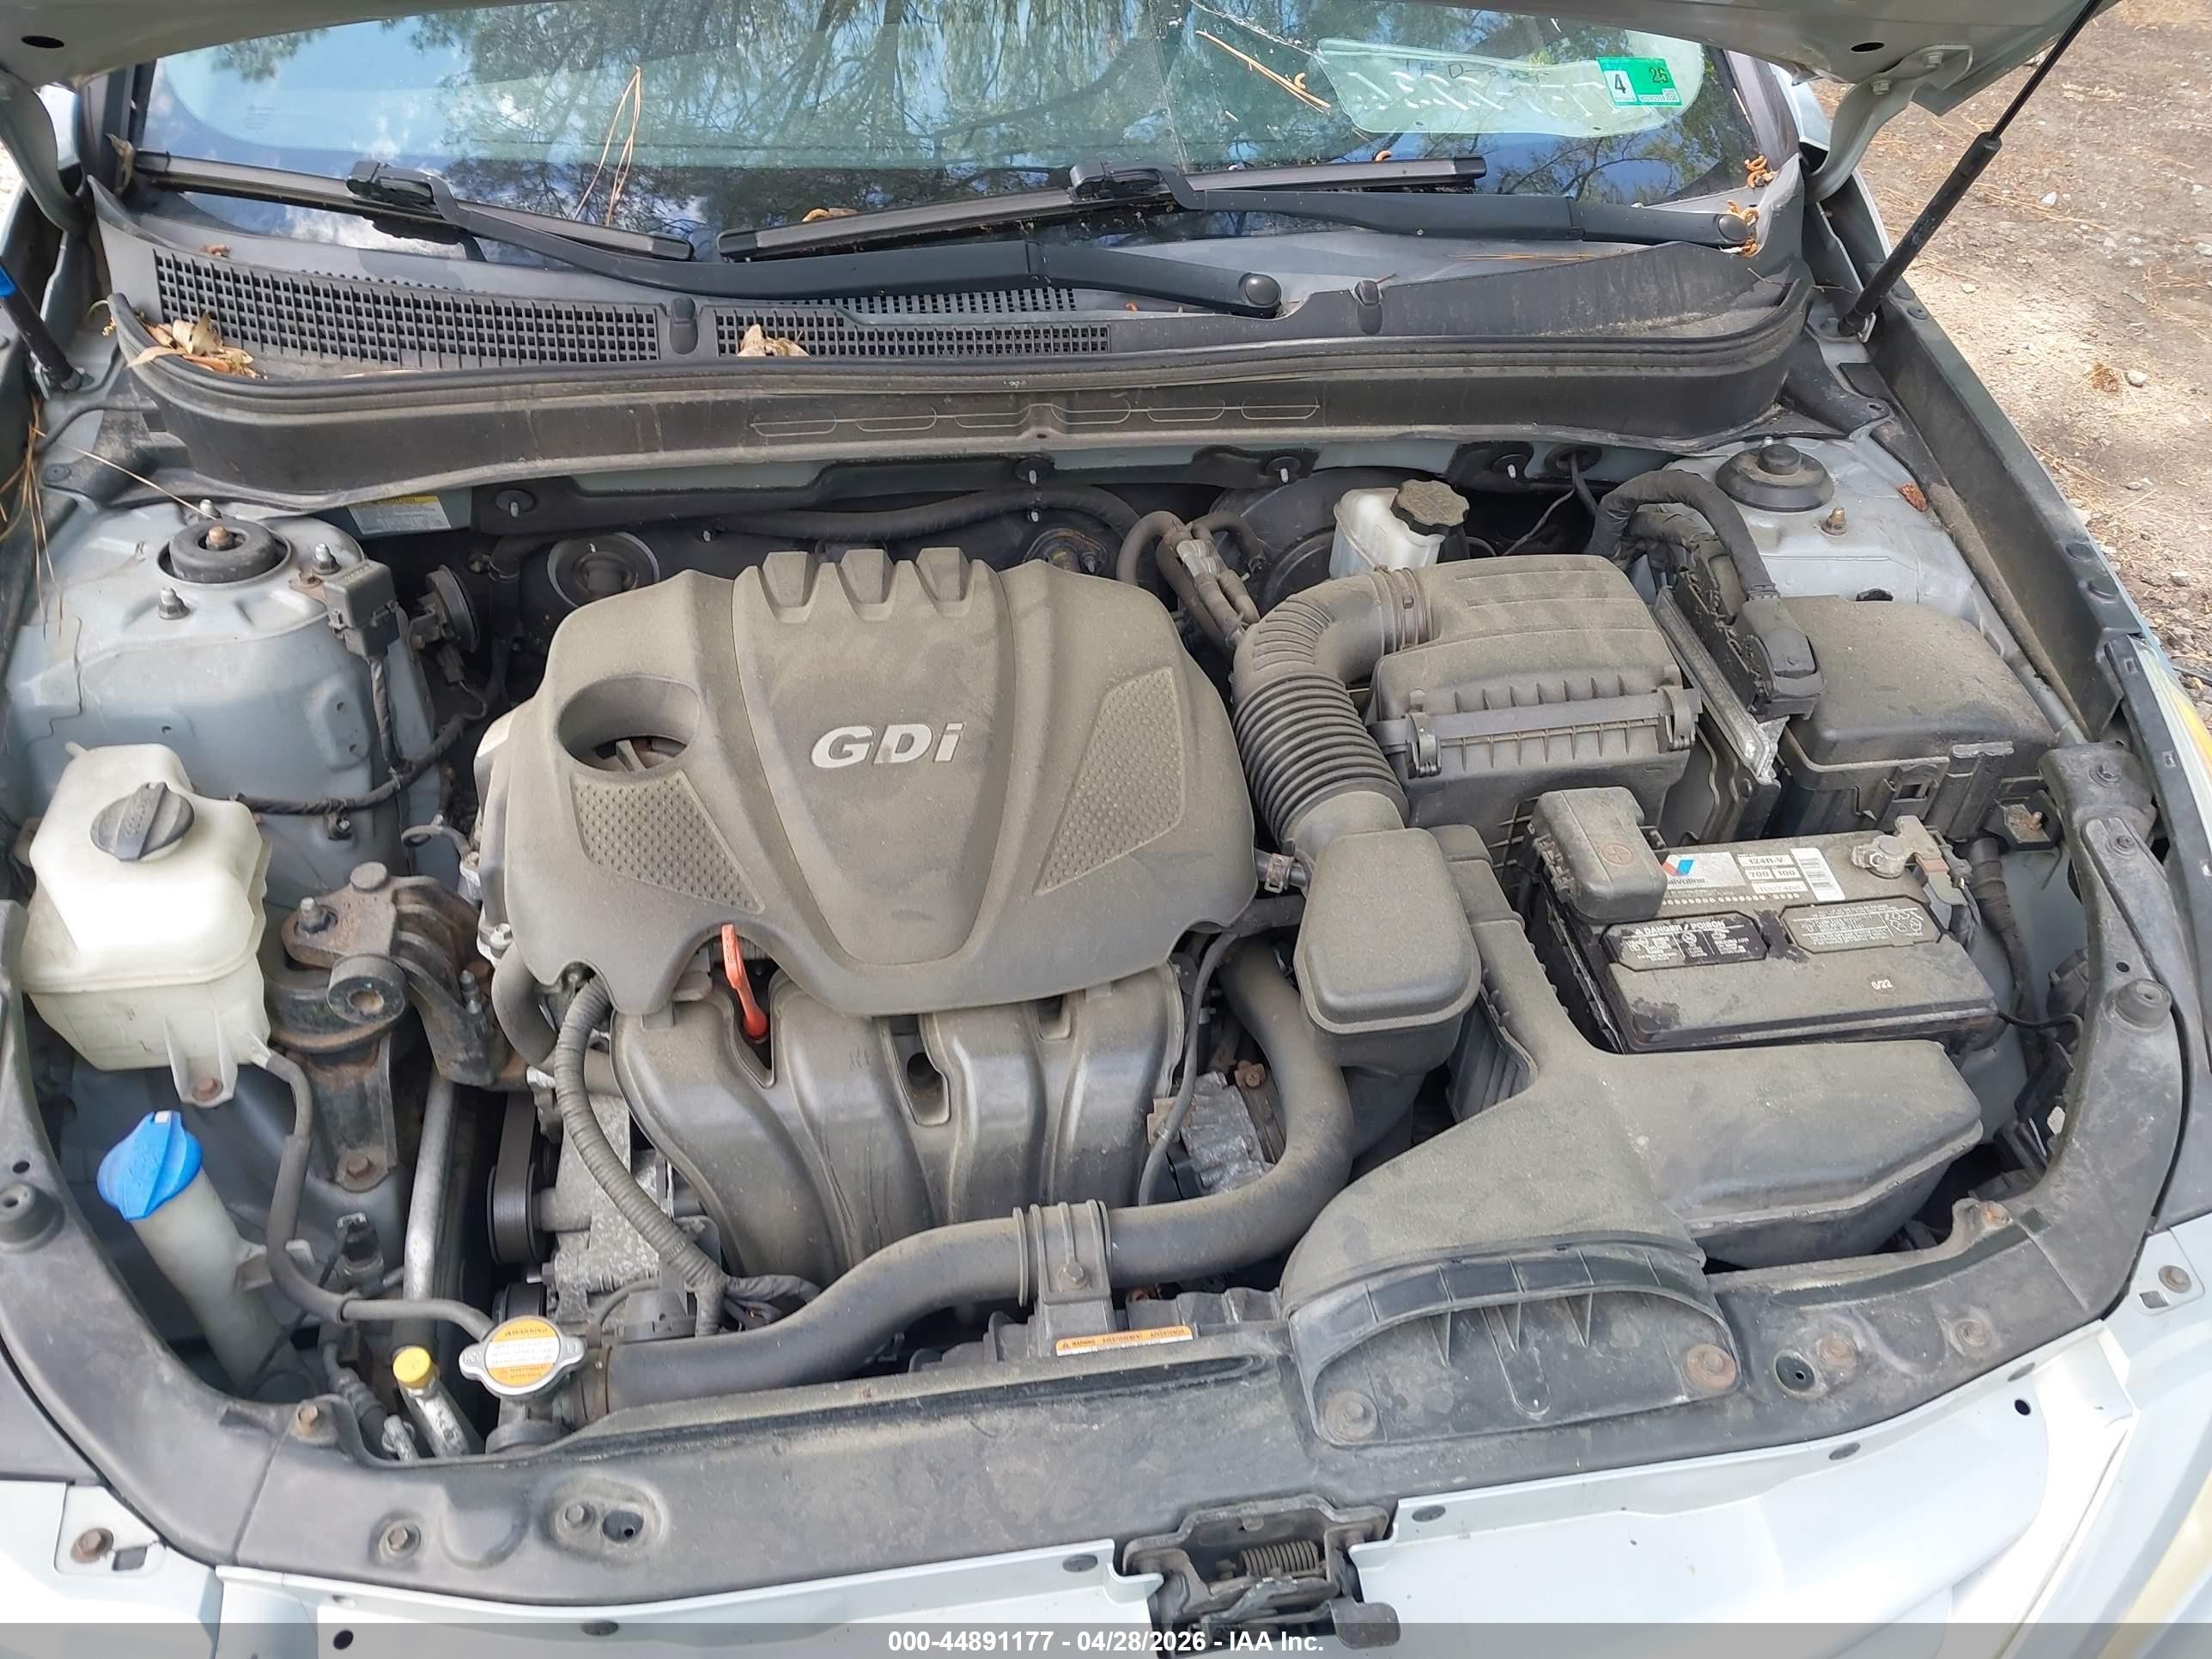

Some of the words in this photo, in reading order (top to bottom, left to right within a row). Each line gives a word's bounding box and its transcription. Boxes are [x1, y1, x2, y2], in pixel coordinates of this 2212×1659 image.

[1614, 74, 1626, 94] 4
[811, 722, 965, 769] GDi
[1750, 870, 1770, 878] 700
[1778, 868, 1796, 877] 100
